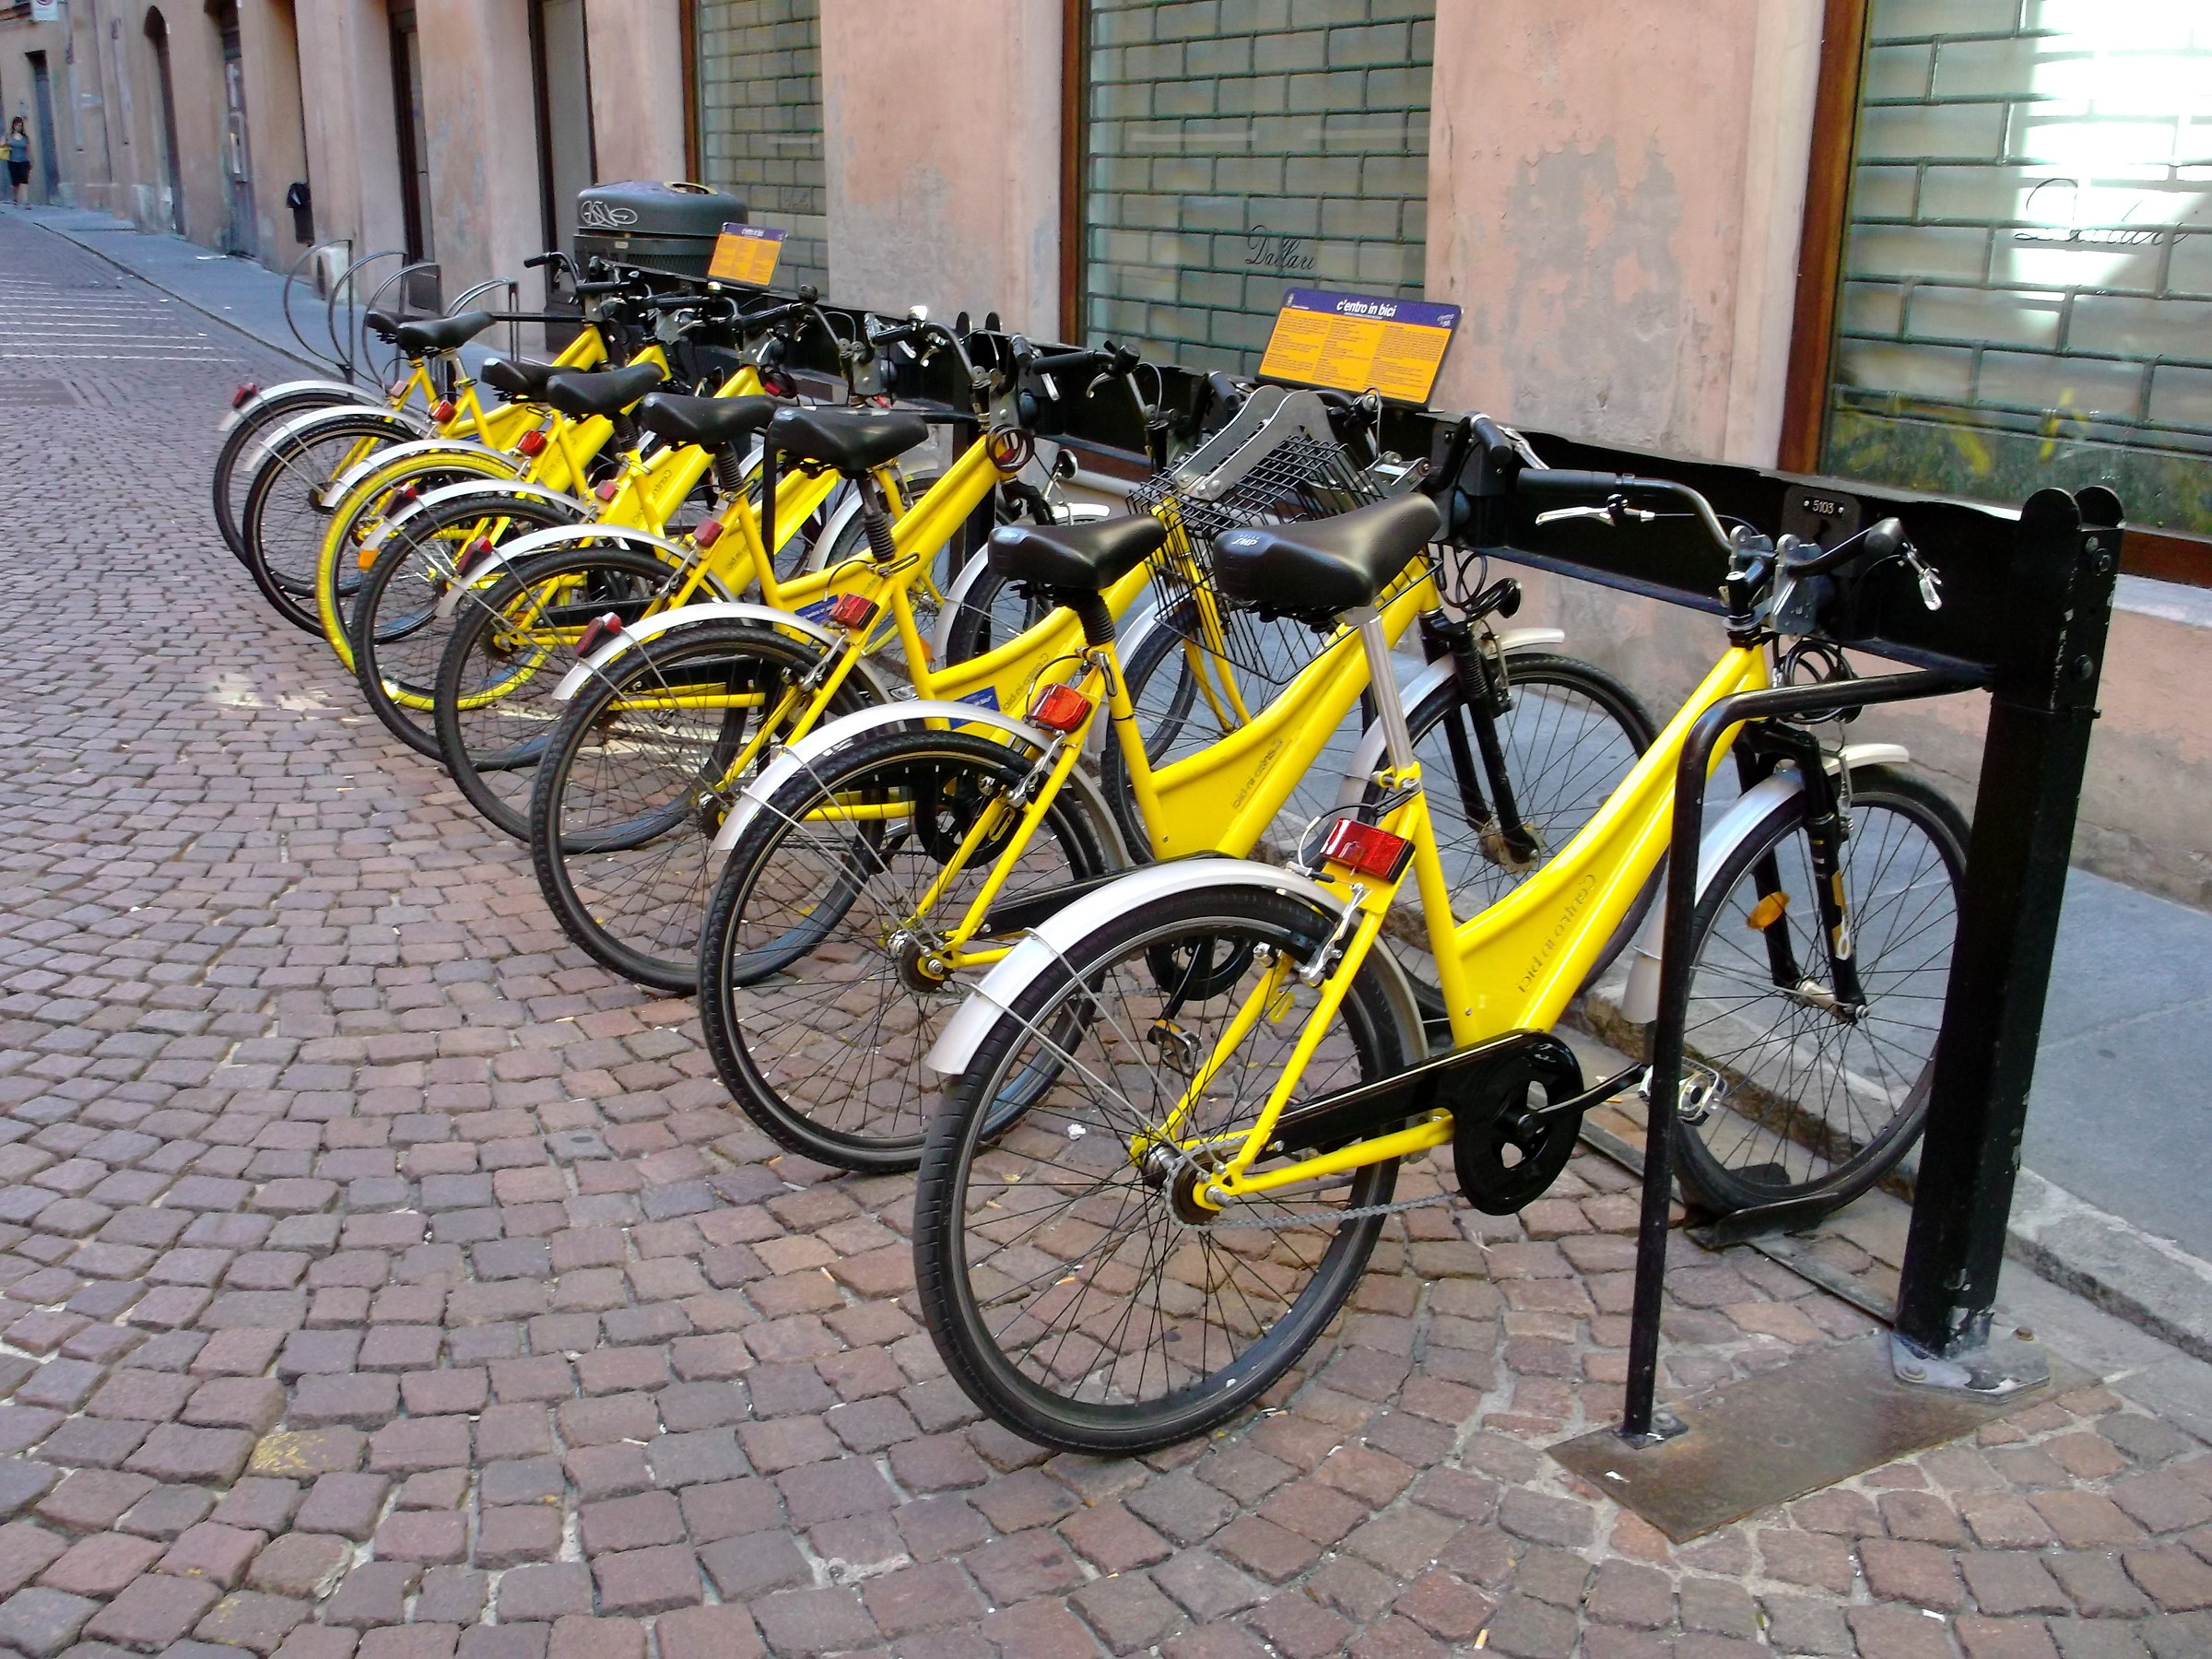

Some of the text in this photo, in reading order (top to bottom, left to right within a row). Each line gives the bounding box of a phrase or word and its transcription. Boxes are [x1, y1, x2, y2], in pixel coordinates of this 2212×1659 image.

[1368, 302, 1379, 315] in
[1378, 302, 1398, 317] bici
[1812, 500, 1834, 514] 5103
